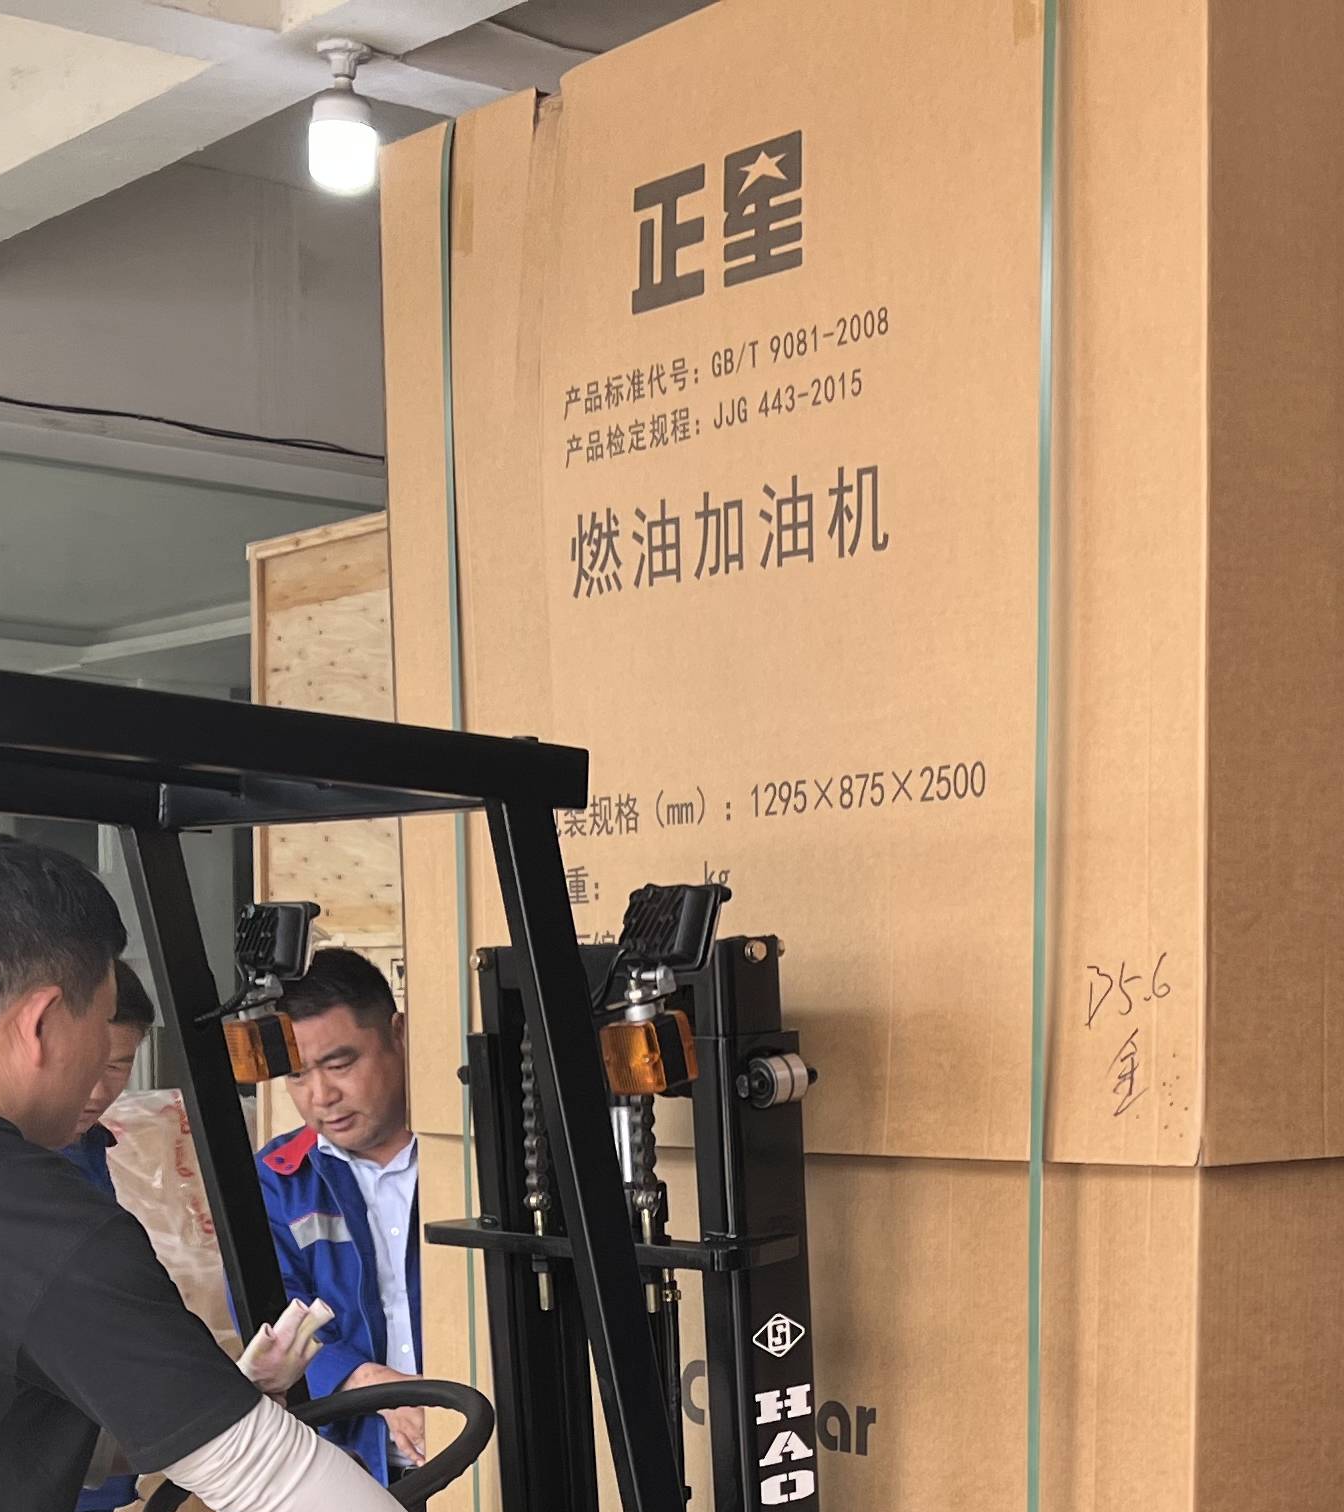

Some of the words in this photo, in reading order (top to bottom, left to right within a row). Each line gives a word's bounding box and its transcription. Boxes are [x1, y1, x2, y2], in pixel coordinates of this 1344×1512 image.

[631, 128, 804, 316] 正星
[711, 340, 759, 378] GB/T
[769, 306, 890, 363] 9081-2008
[713, 396, 748, 430] JJG
[758, 368, 864, 418] 443-2015
[570, 464, 890, 600] 燃油加油机
[755, 1383, 814, 1506] HAO
